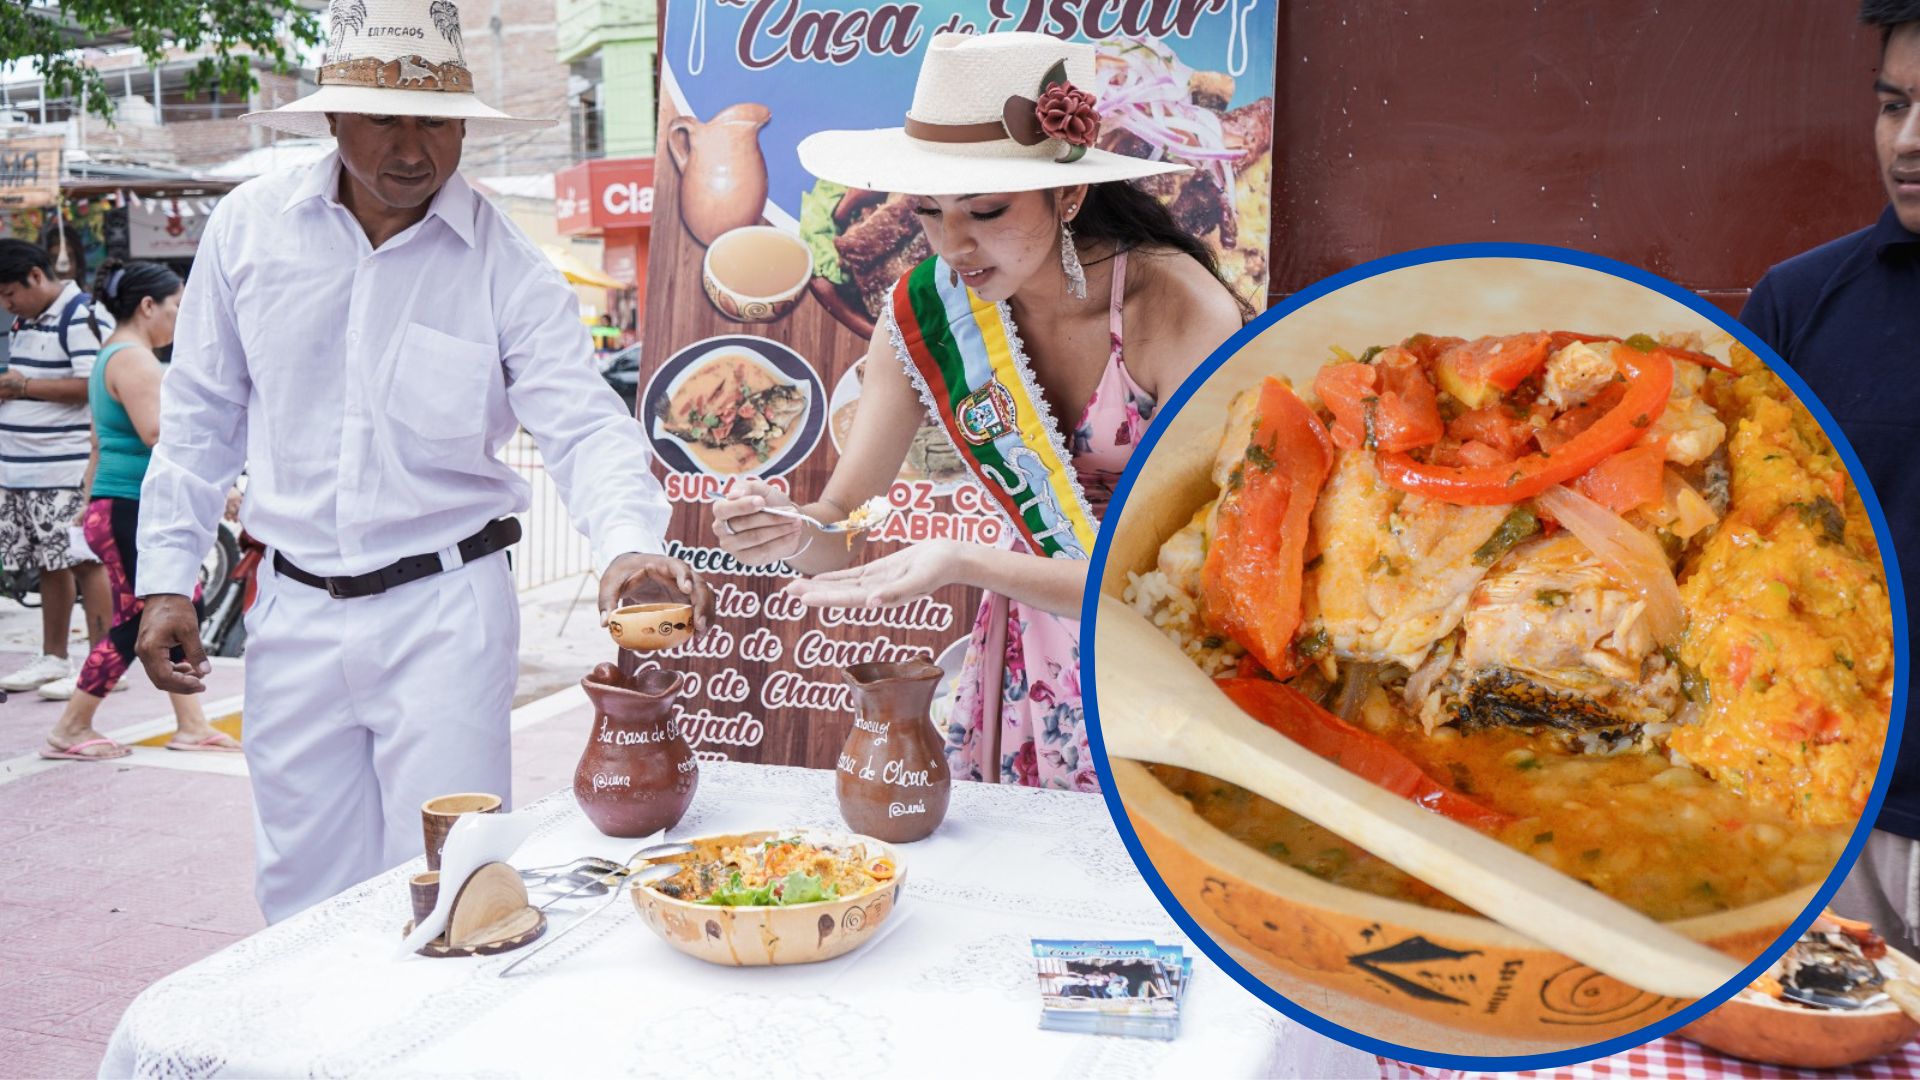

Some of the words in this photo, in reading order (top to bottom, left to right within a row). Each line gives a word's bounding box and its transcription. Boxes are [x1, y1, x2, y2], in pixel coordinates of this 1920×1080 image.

[738, 0, 922, 68] Casa
[603, 182, 654, 215] Cla
[742, 631, 779, 658] de
[711, 672, 746, 699] de
[616, 730, 650, 745] casa
[652, 723, 665, 743] de
